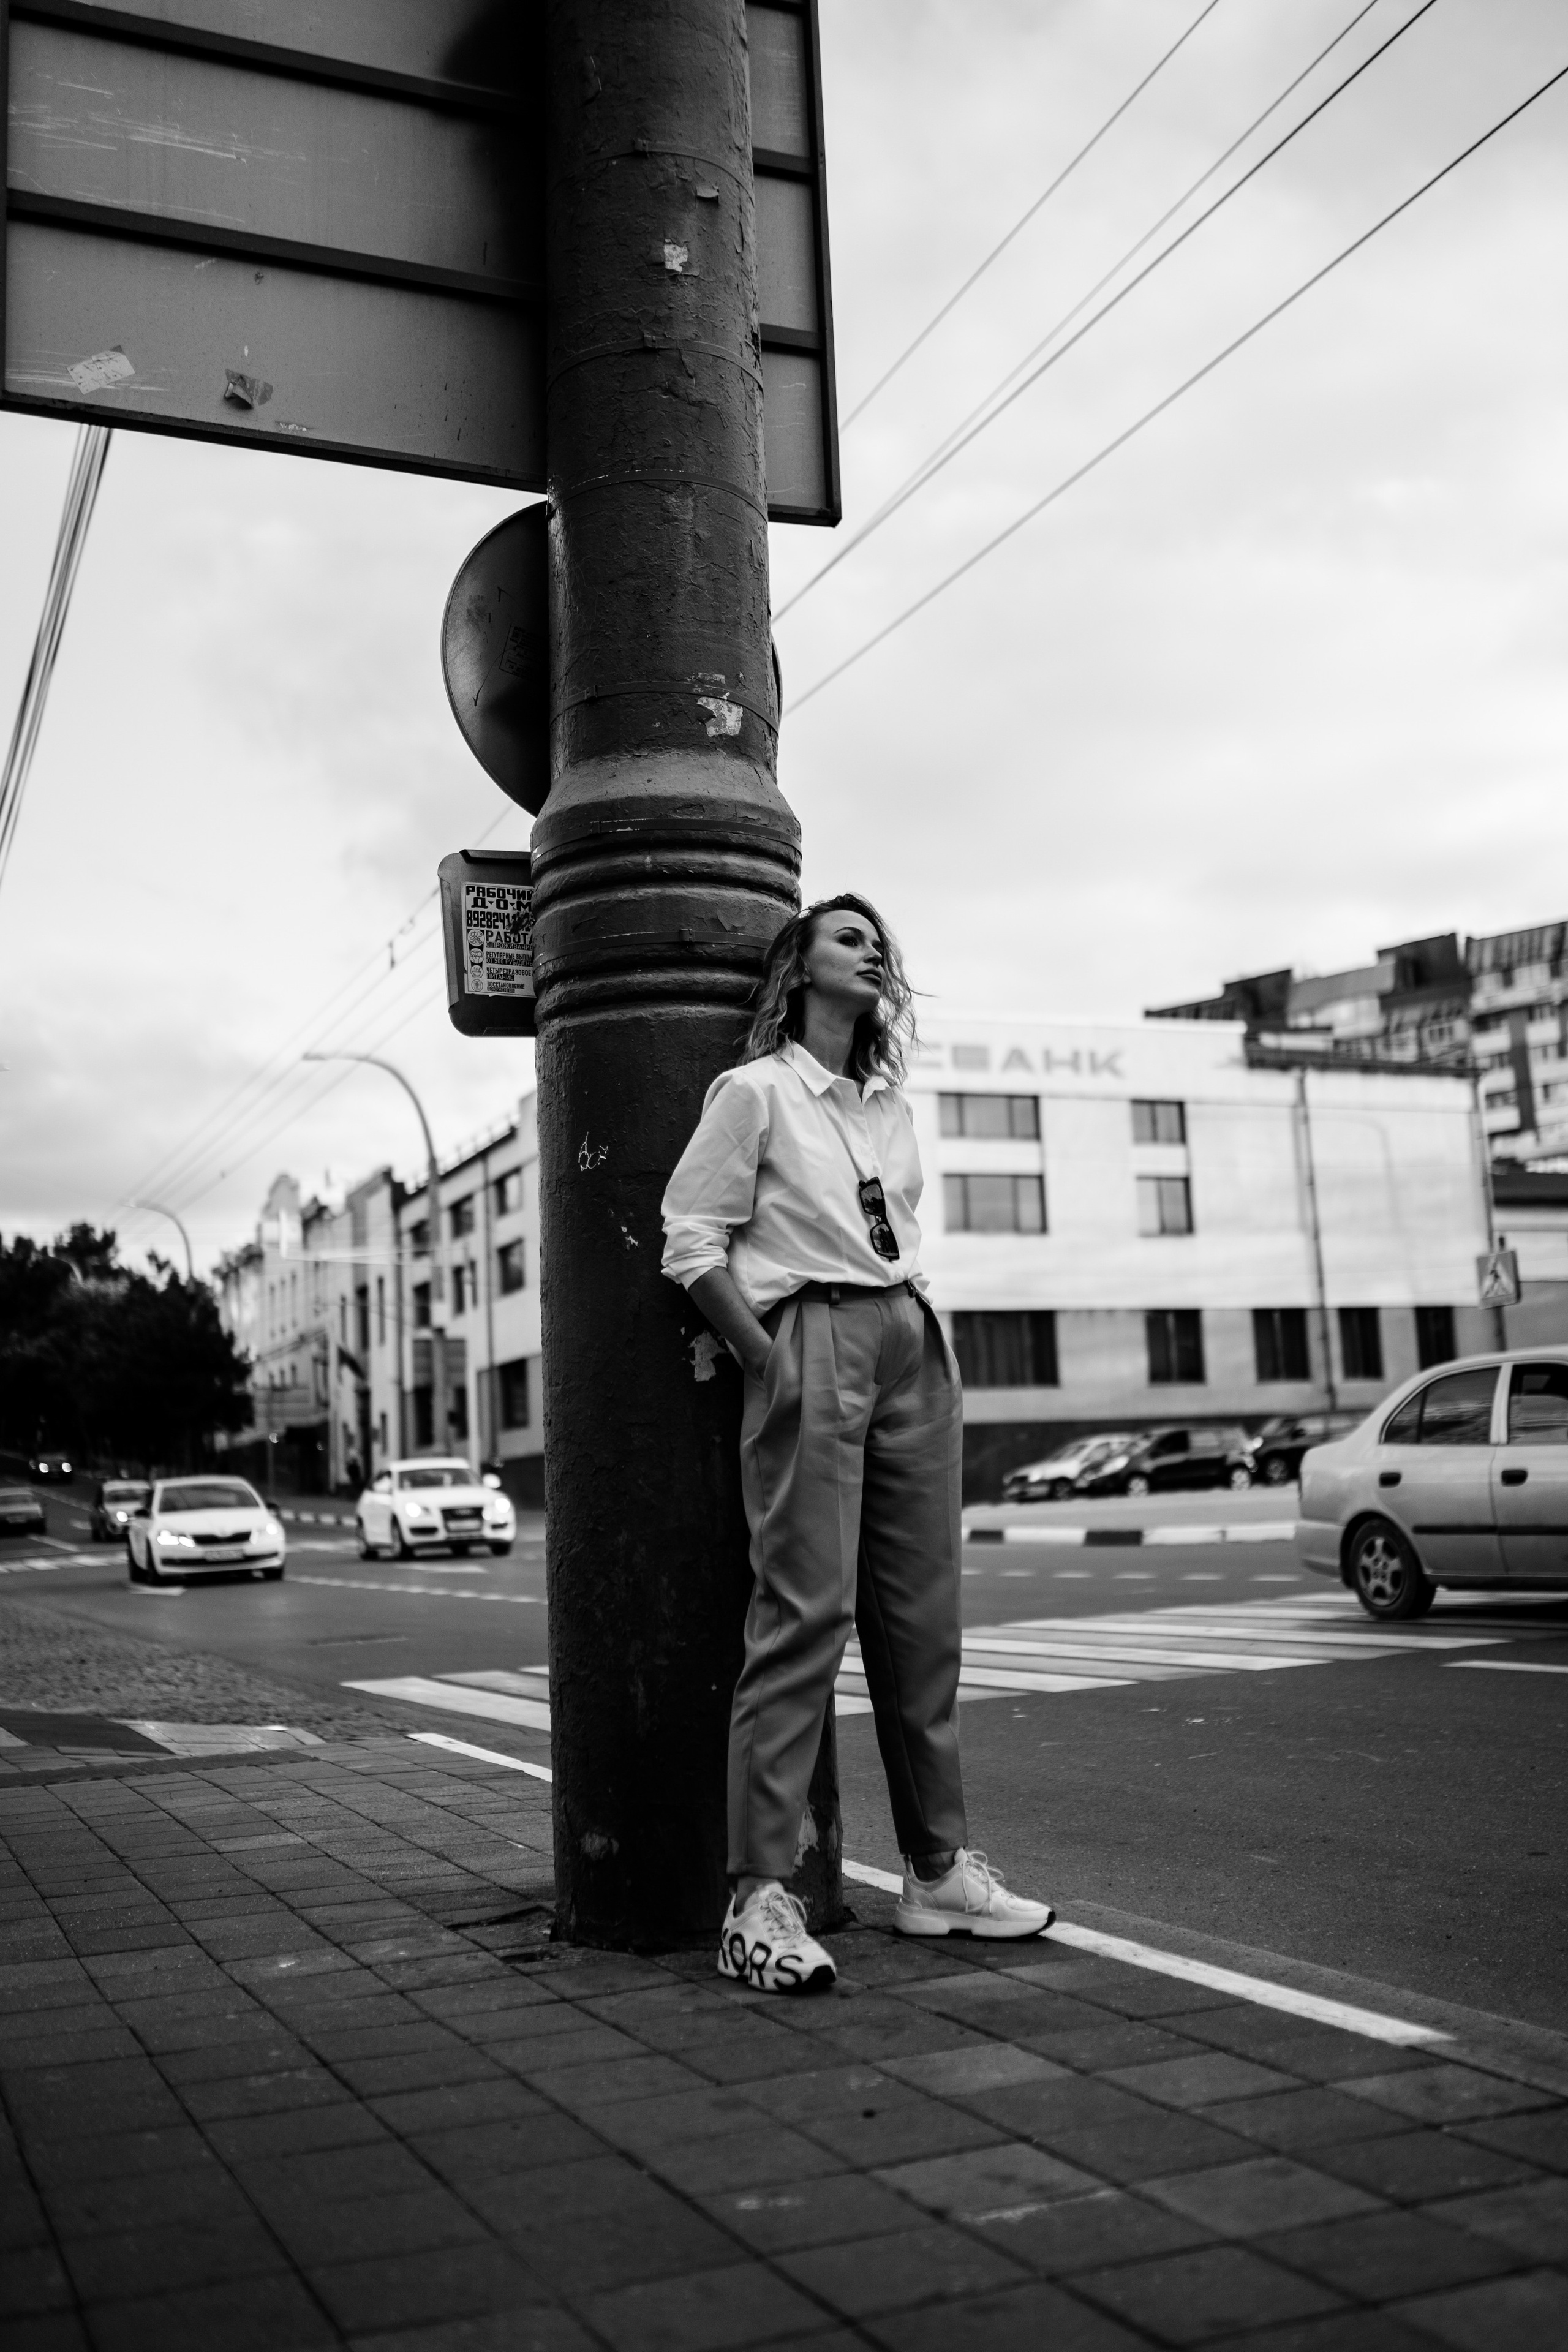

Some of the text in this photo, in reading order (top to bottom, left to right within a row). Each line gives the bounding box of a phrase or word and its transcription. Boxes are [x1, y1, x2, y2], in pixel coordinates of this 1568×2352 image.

[467, 910, 535, 932] 8928241
[487, 967, 532, 976] ЧЕТЫРЕХРАЗОВОЕ
[487, 981, 525, 990] ВОССТАНОВЛЕНИЕ
